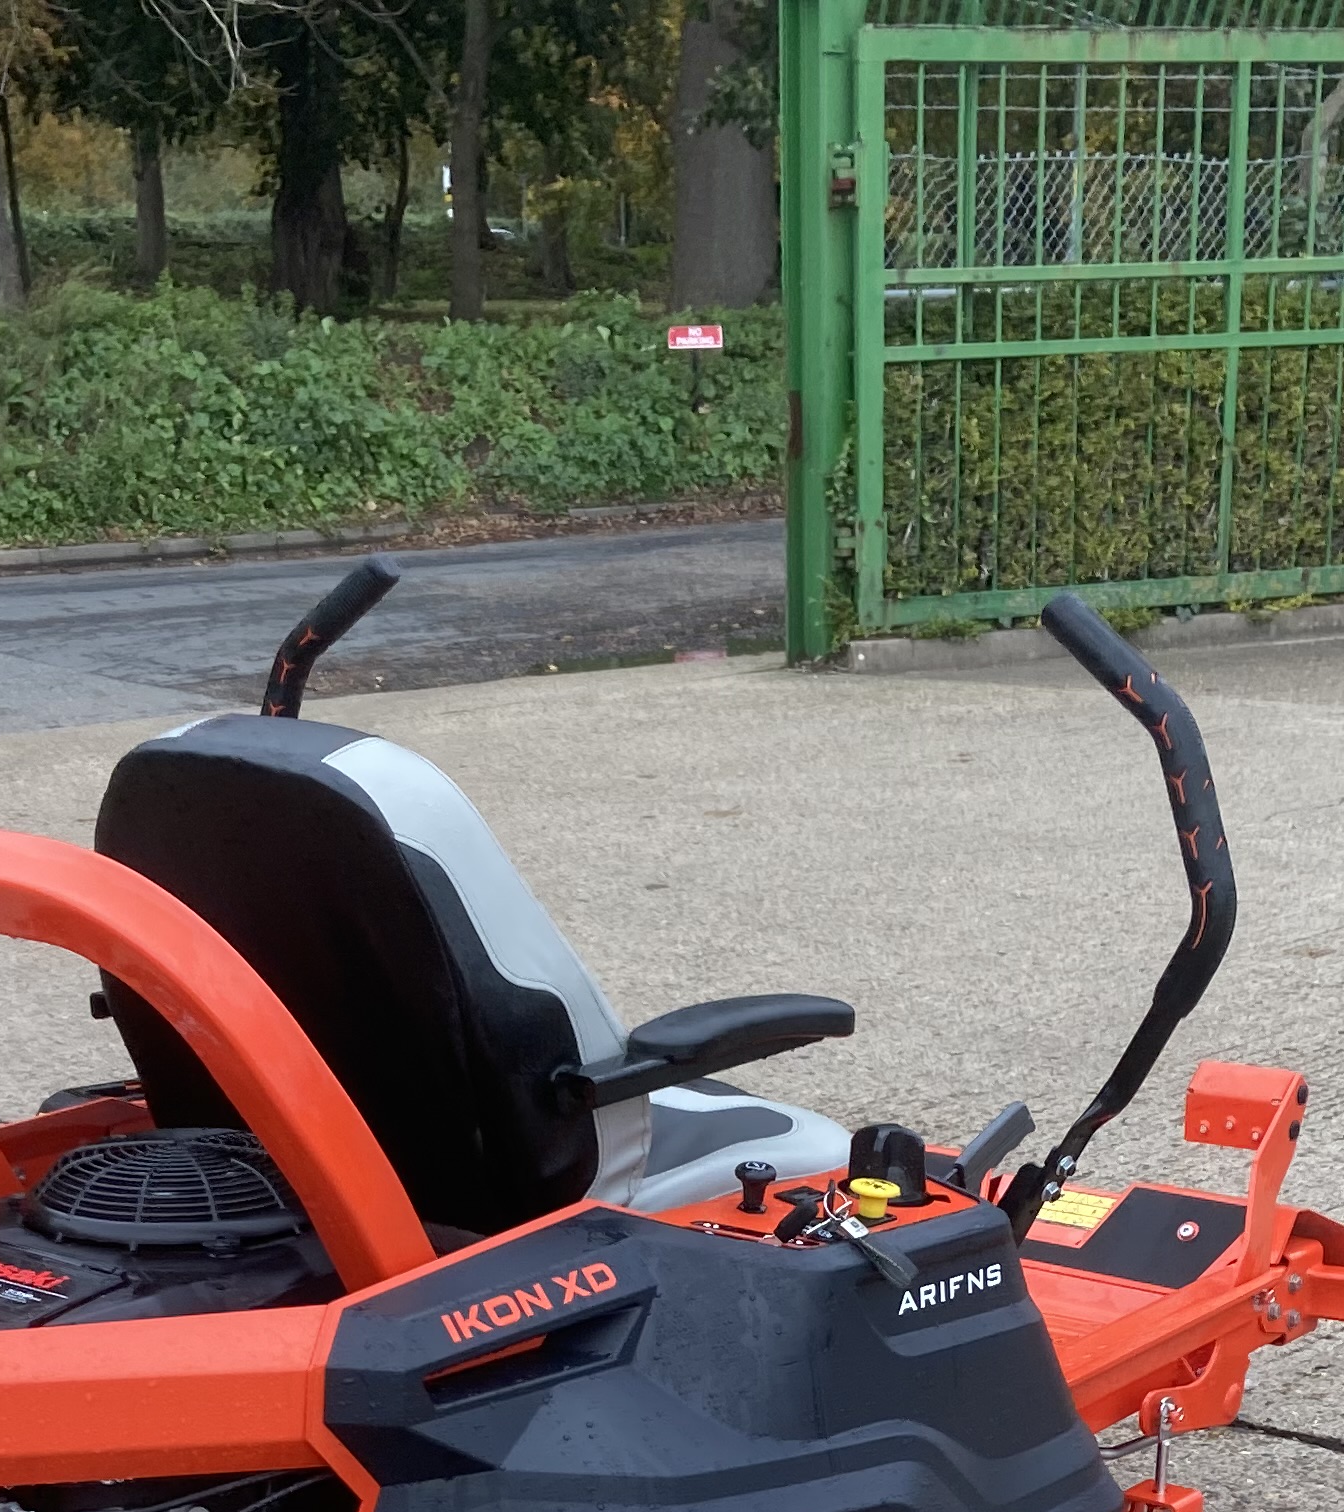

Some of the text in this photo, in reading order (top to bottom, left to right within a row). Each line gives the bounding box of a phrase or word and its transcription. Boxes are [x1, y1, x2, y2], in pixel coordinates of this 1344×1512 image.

[688, 327, 703, 337] NO
[441, 1262, 617, 1343] IKON XD
